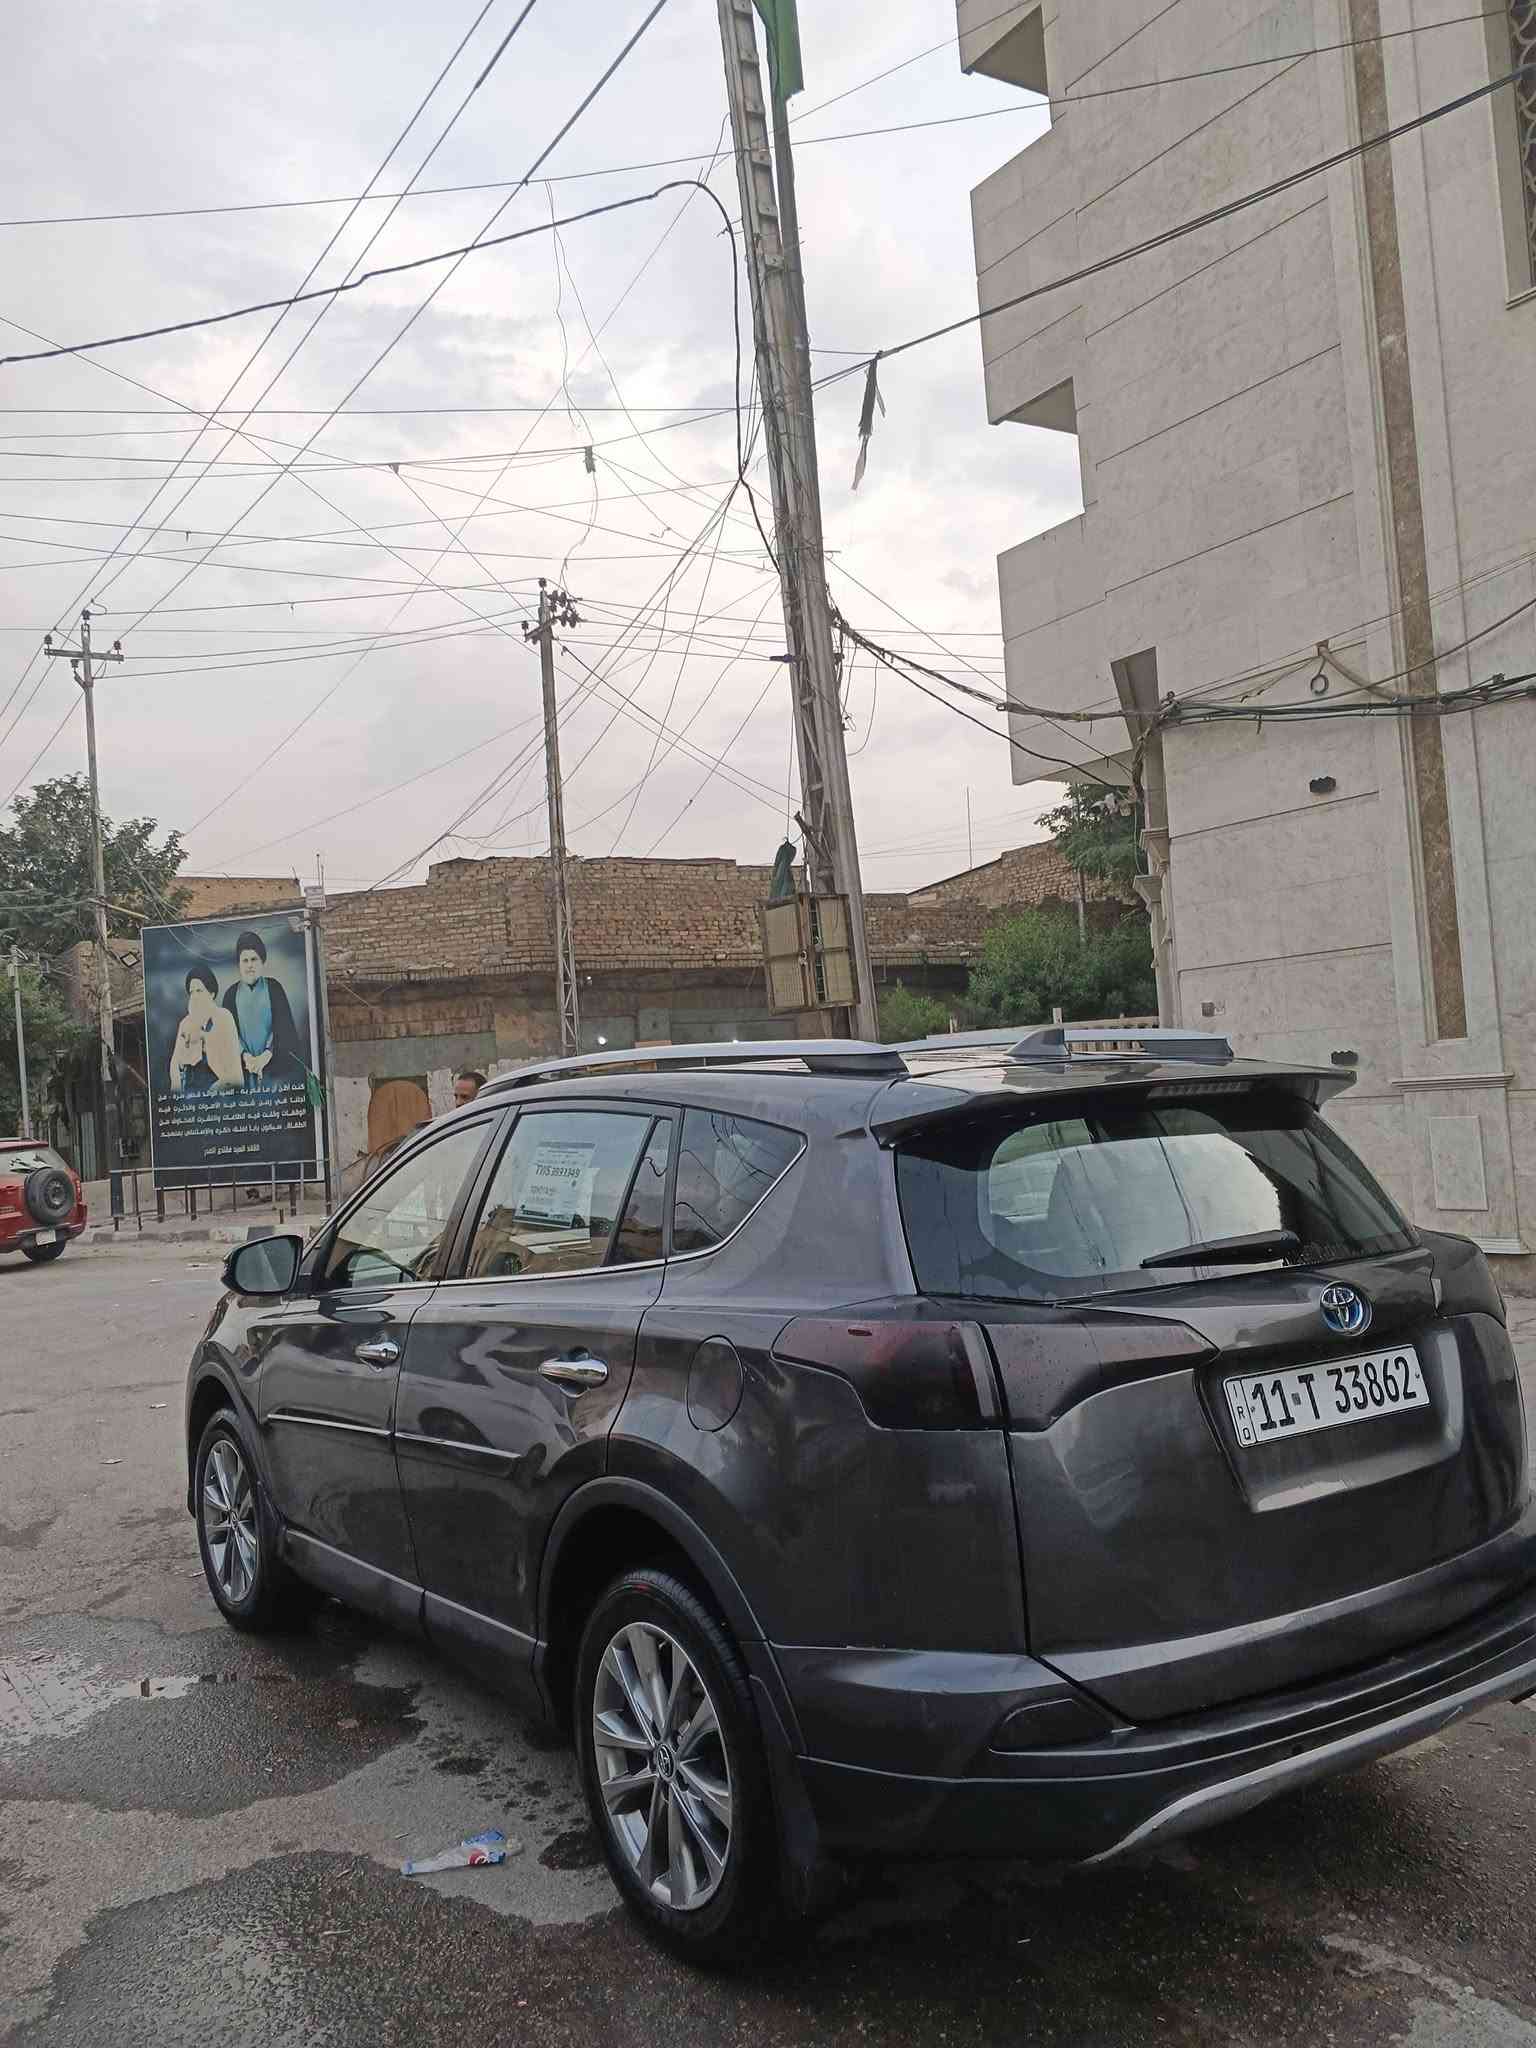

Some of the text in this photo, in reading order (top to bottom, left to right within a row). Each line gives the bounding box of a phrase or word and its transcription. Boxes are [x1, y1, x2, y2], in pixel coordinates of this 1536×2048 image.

[1252, 1356, 1417, 1431] 11 T 33862
